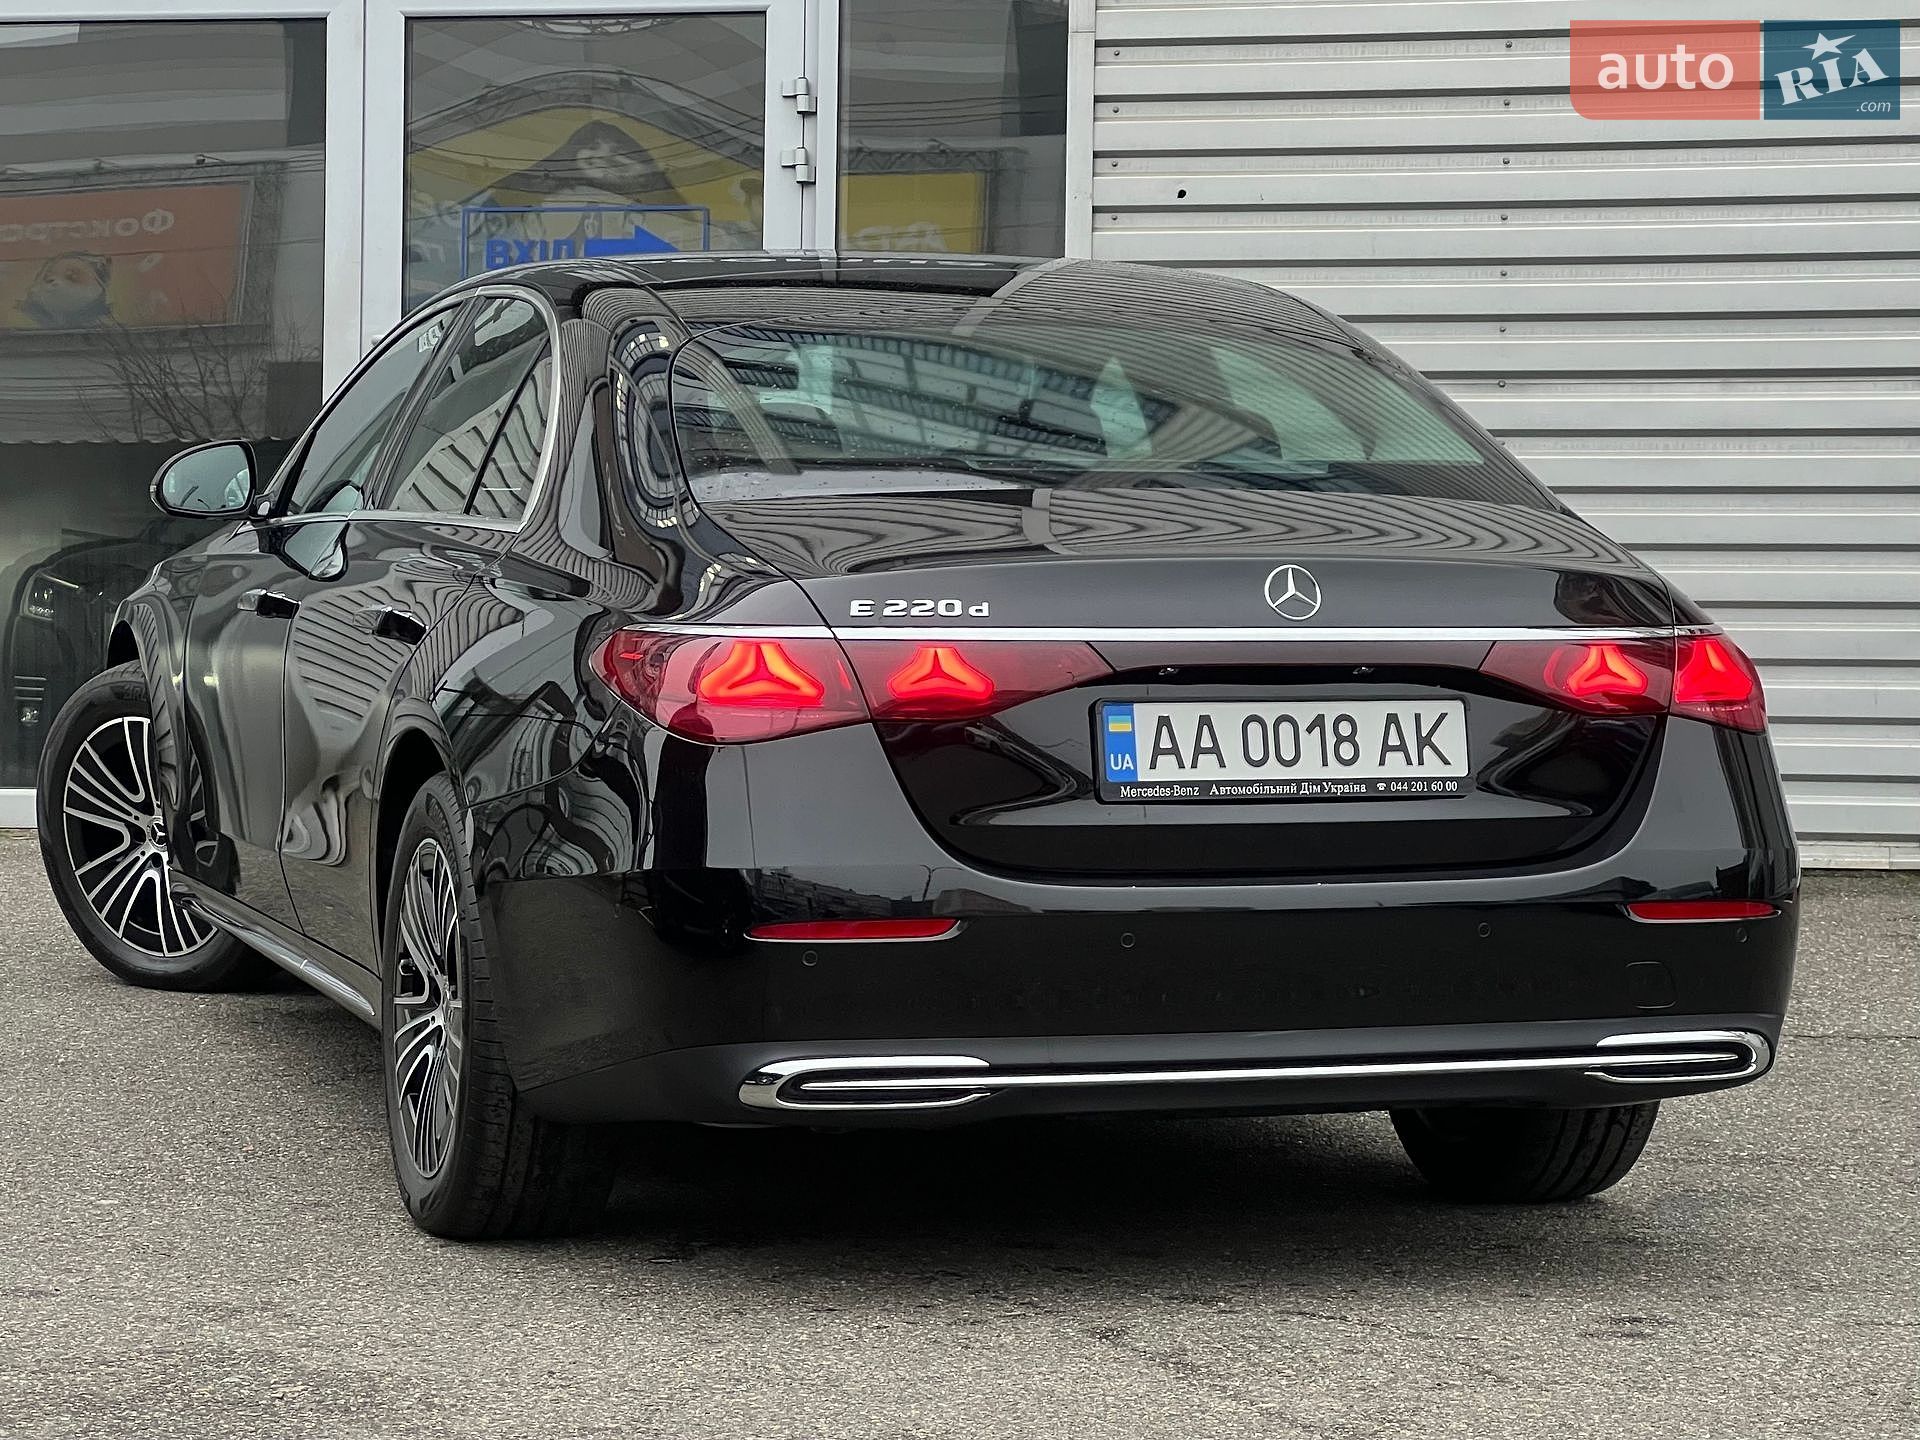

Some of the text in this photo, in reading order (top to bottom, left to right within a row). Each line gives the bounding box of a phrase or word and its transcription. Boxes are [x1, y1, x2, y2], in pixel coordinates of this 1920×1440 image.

[850, 599, 875, 617] E
[1149, 712, 1452, 769] AA 0018 AK
[1110, 753, 1134, 772] UA
[1120, 780, 1458, 798] Mercedes-Benz Автомобільний Дім Україна 044 201 60 00
